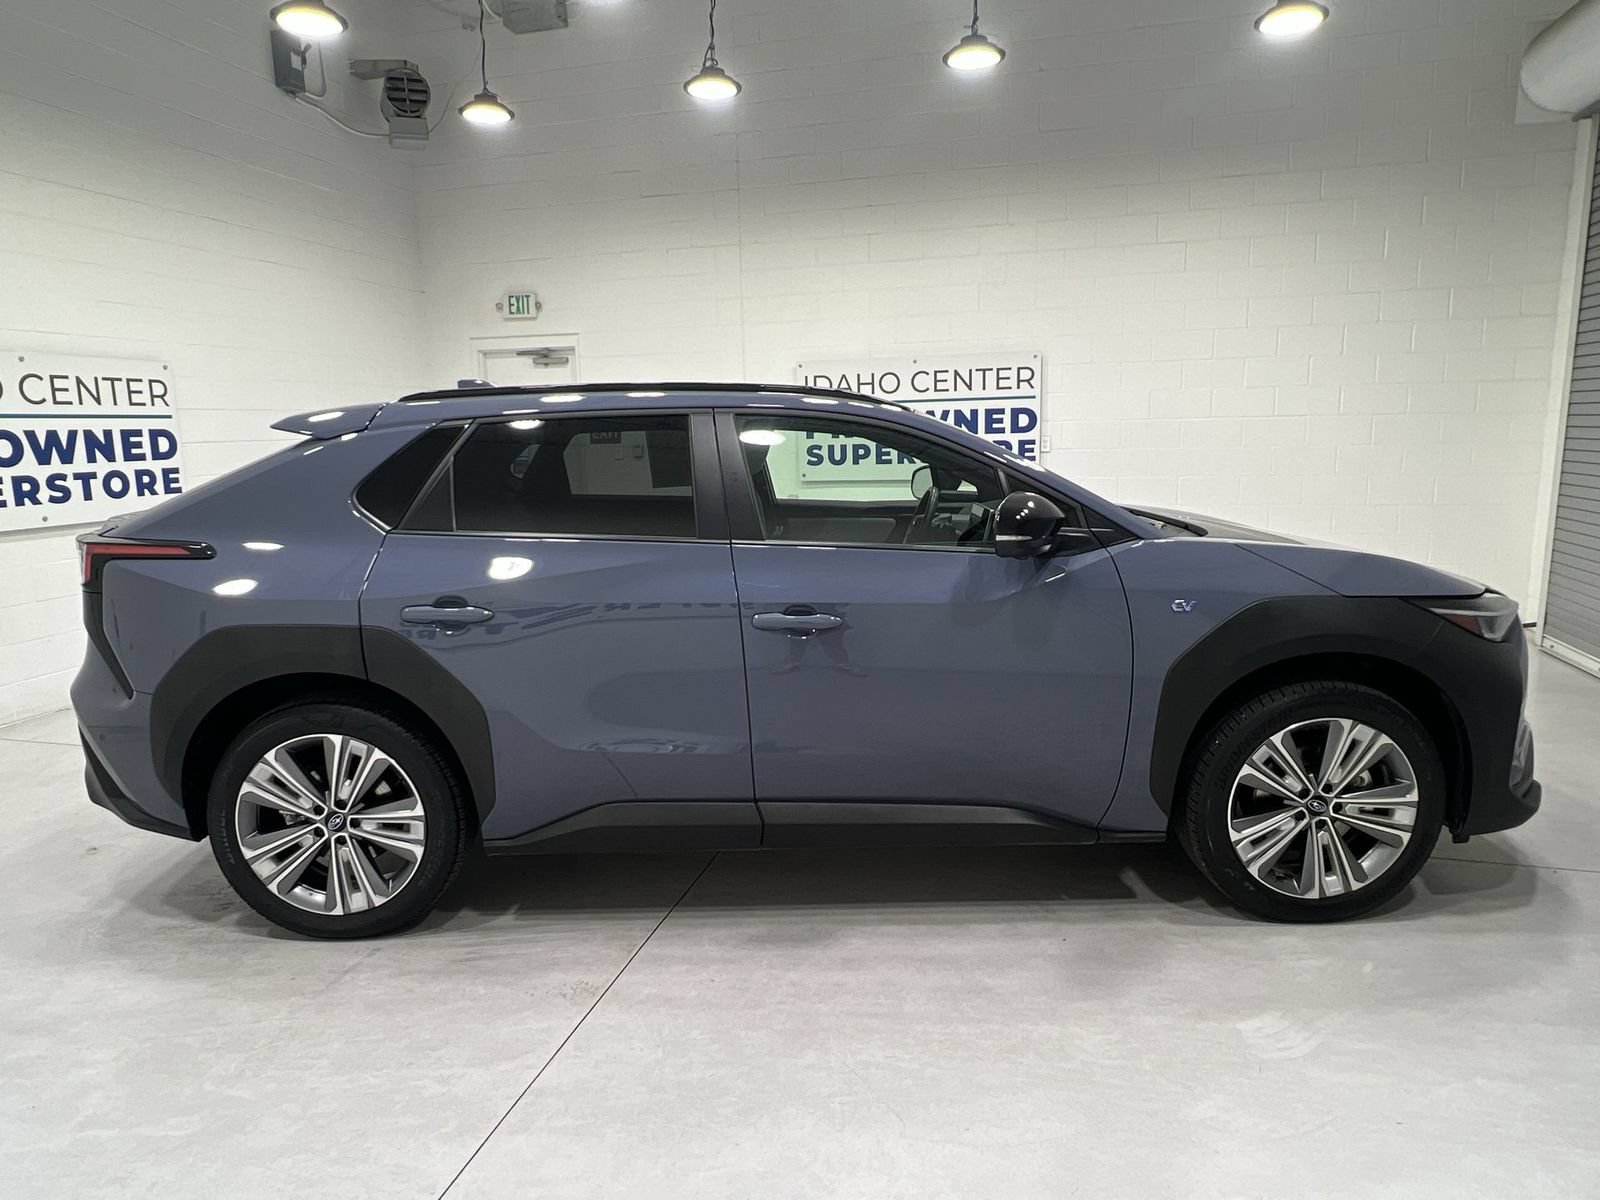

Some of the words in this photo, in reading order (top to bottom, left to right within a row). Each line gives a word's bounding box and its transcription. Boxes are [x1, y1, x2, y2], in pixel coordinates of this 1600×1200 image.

[508, 295, 531, 315] EXIT
[18, 373, 170, 407] CENTER
[910, 366, 1035, 393] CENTER
[1171, 599, 1197, 612] EV
